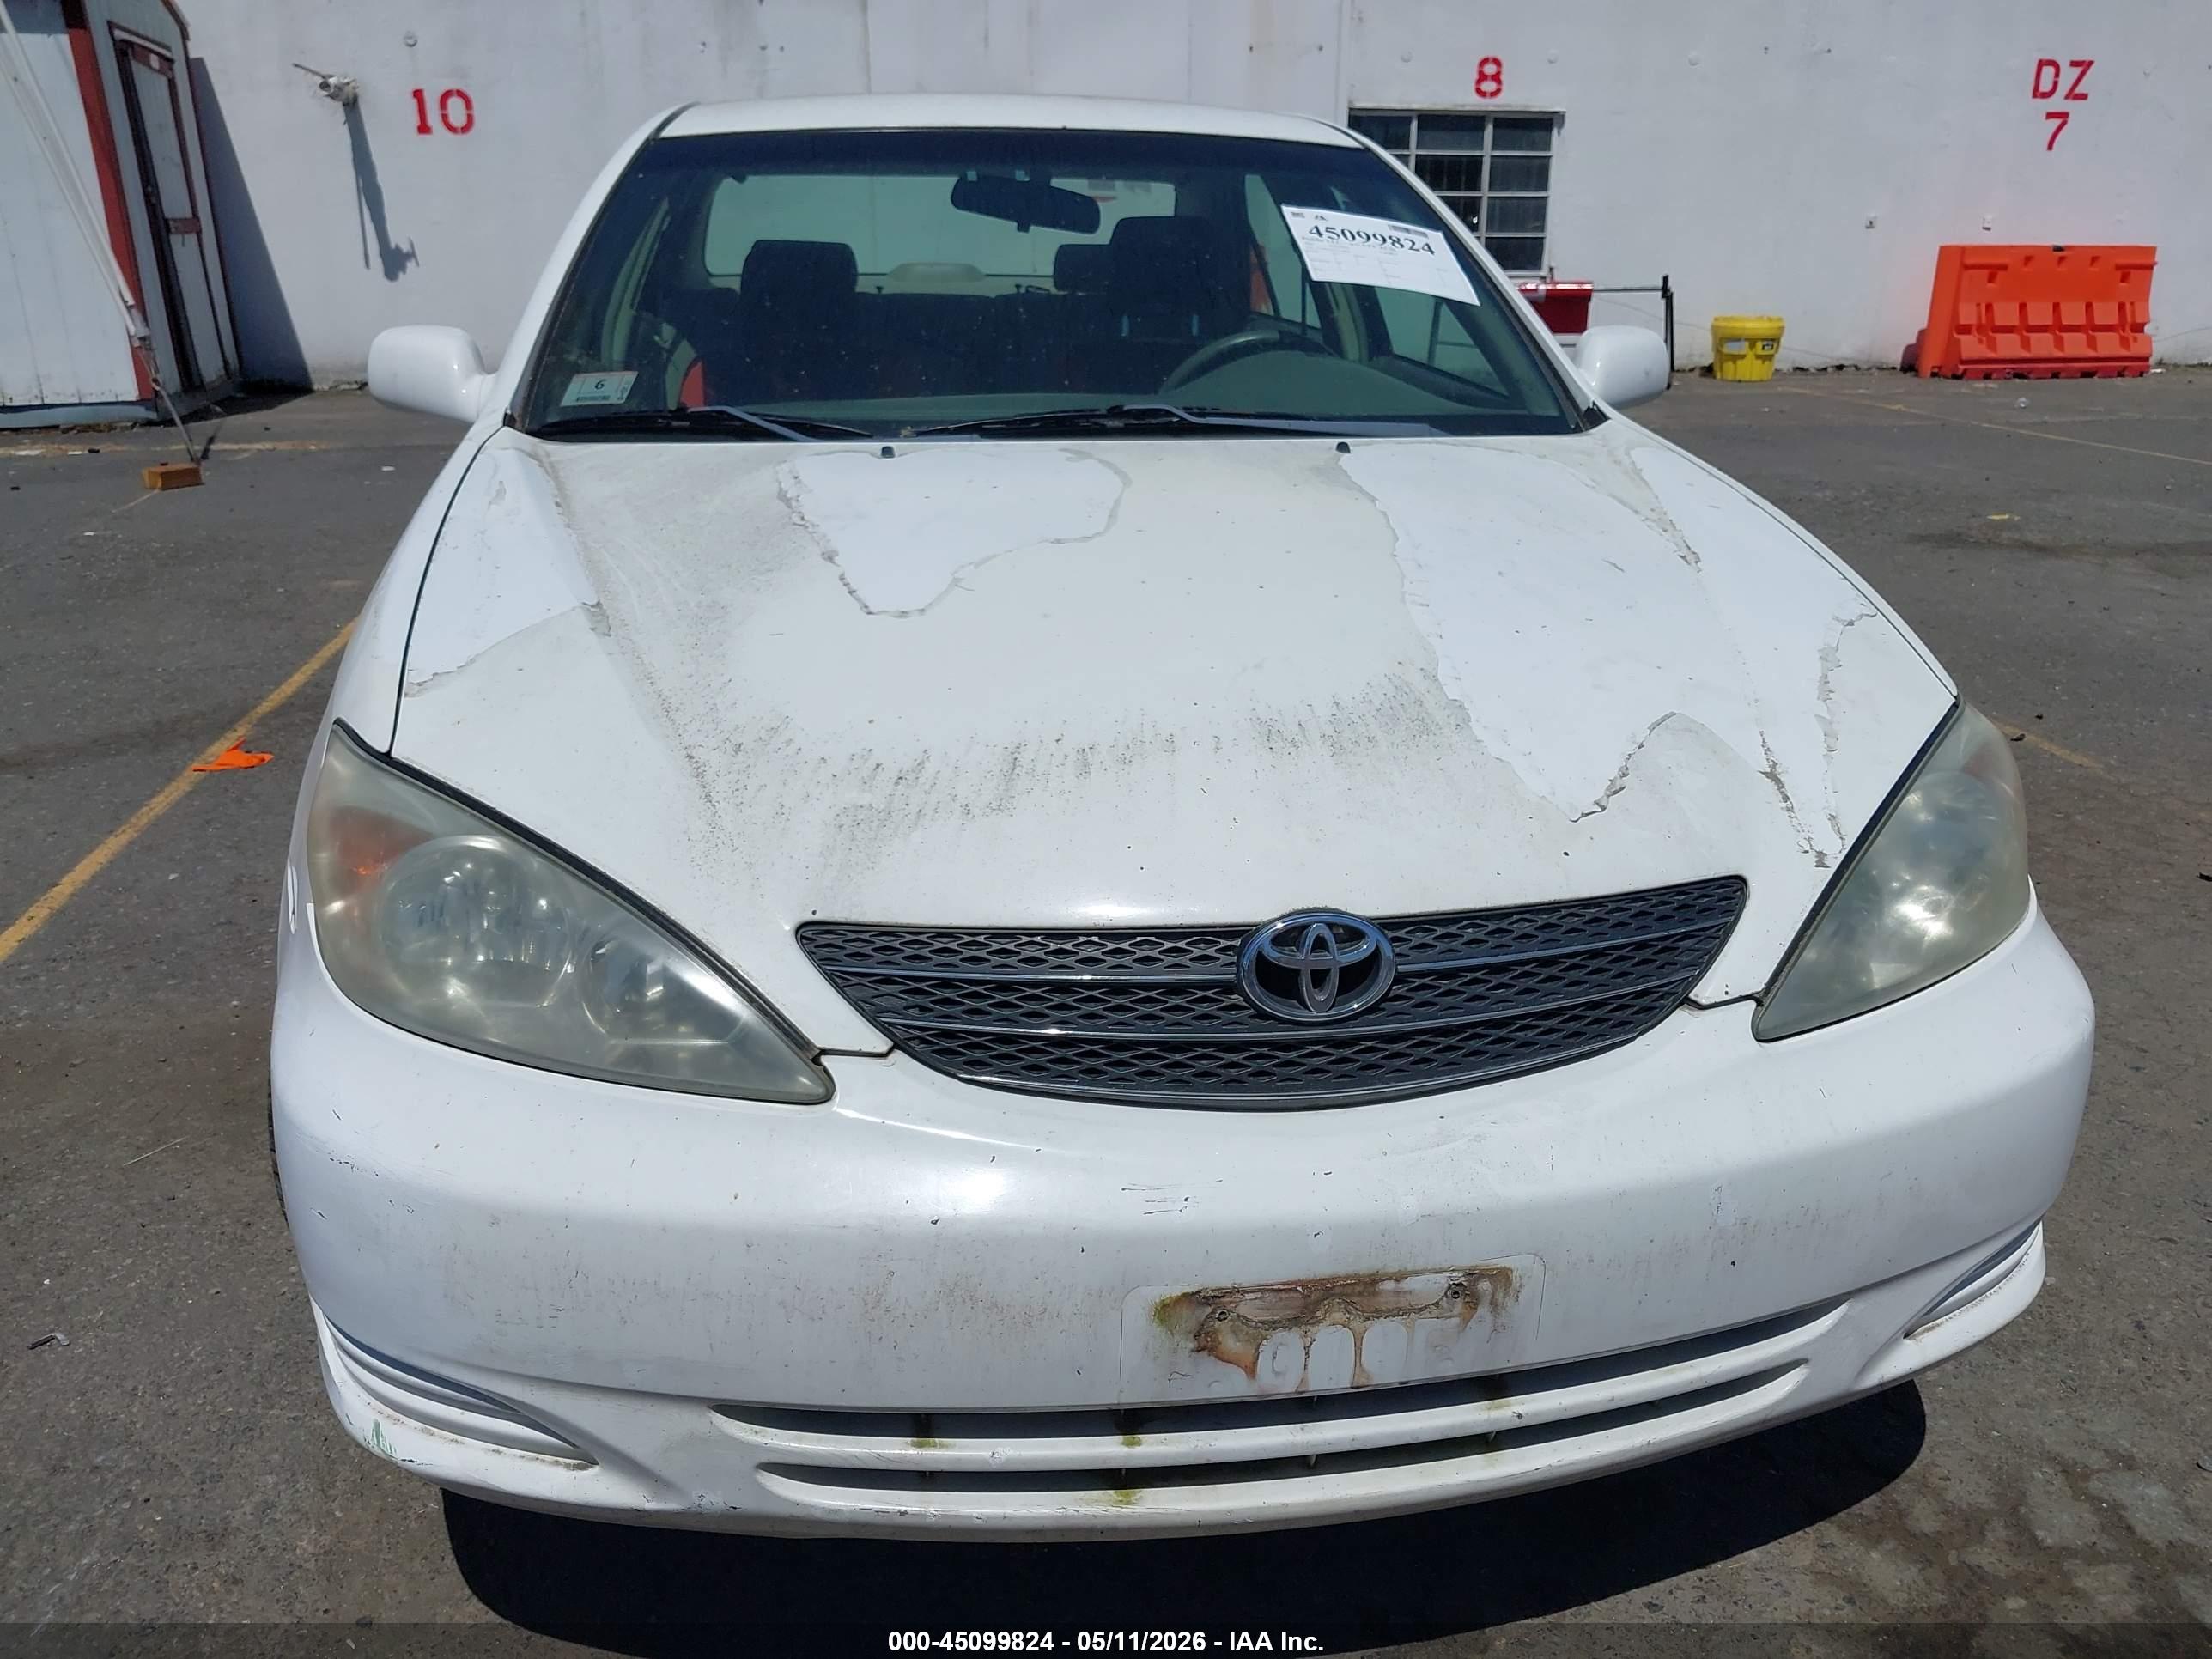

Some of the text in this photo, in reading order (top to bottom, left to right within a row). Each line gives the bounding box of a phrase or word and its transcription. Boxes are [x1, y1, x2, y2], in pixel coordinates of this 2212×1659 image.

[1474, 57, 1504, 99] 8
[2032, 58, 2094, 101] DZ
[411, 88, 475, 135] 10
[2045, 111, 2070, 151] 7
[1309, 224, 1436, 256] 45099824
[594, 379, 607, 390] 6
